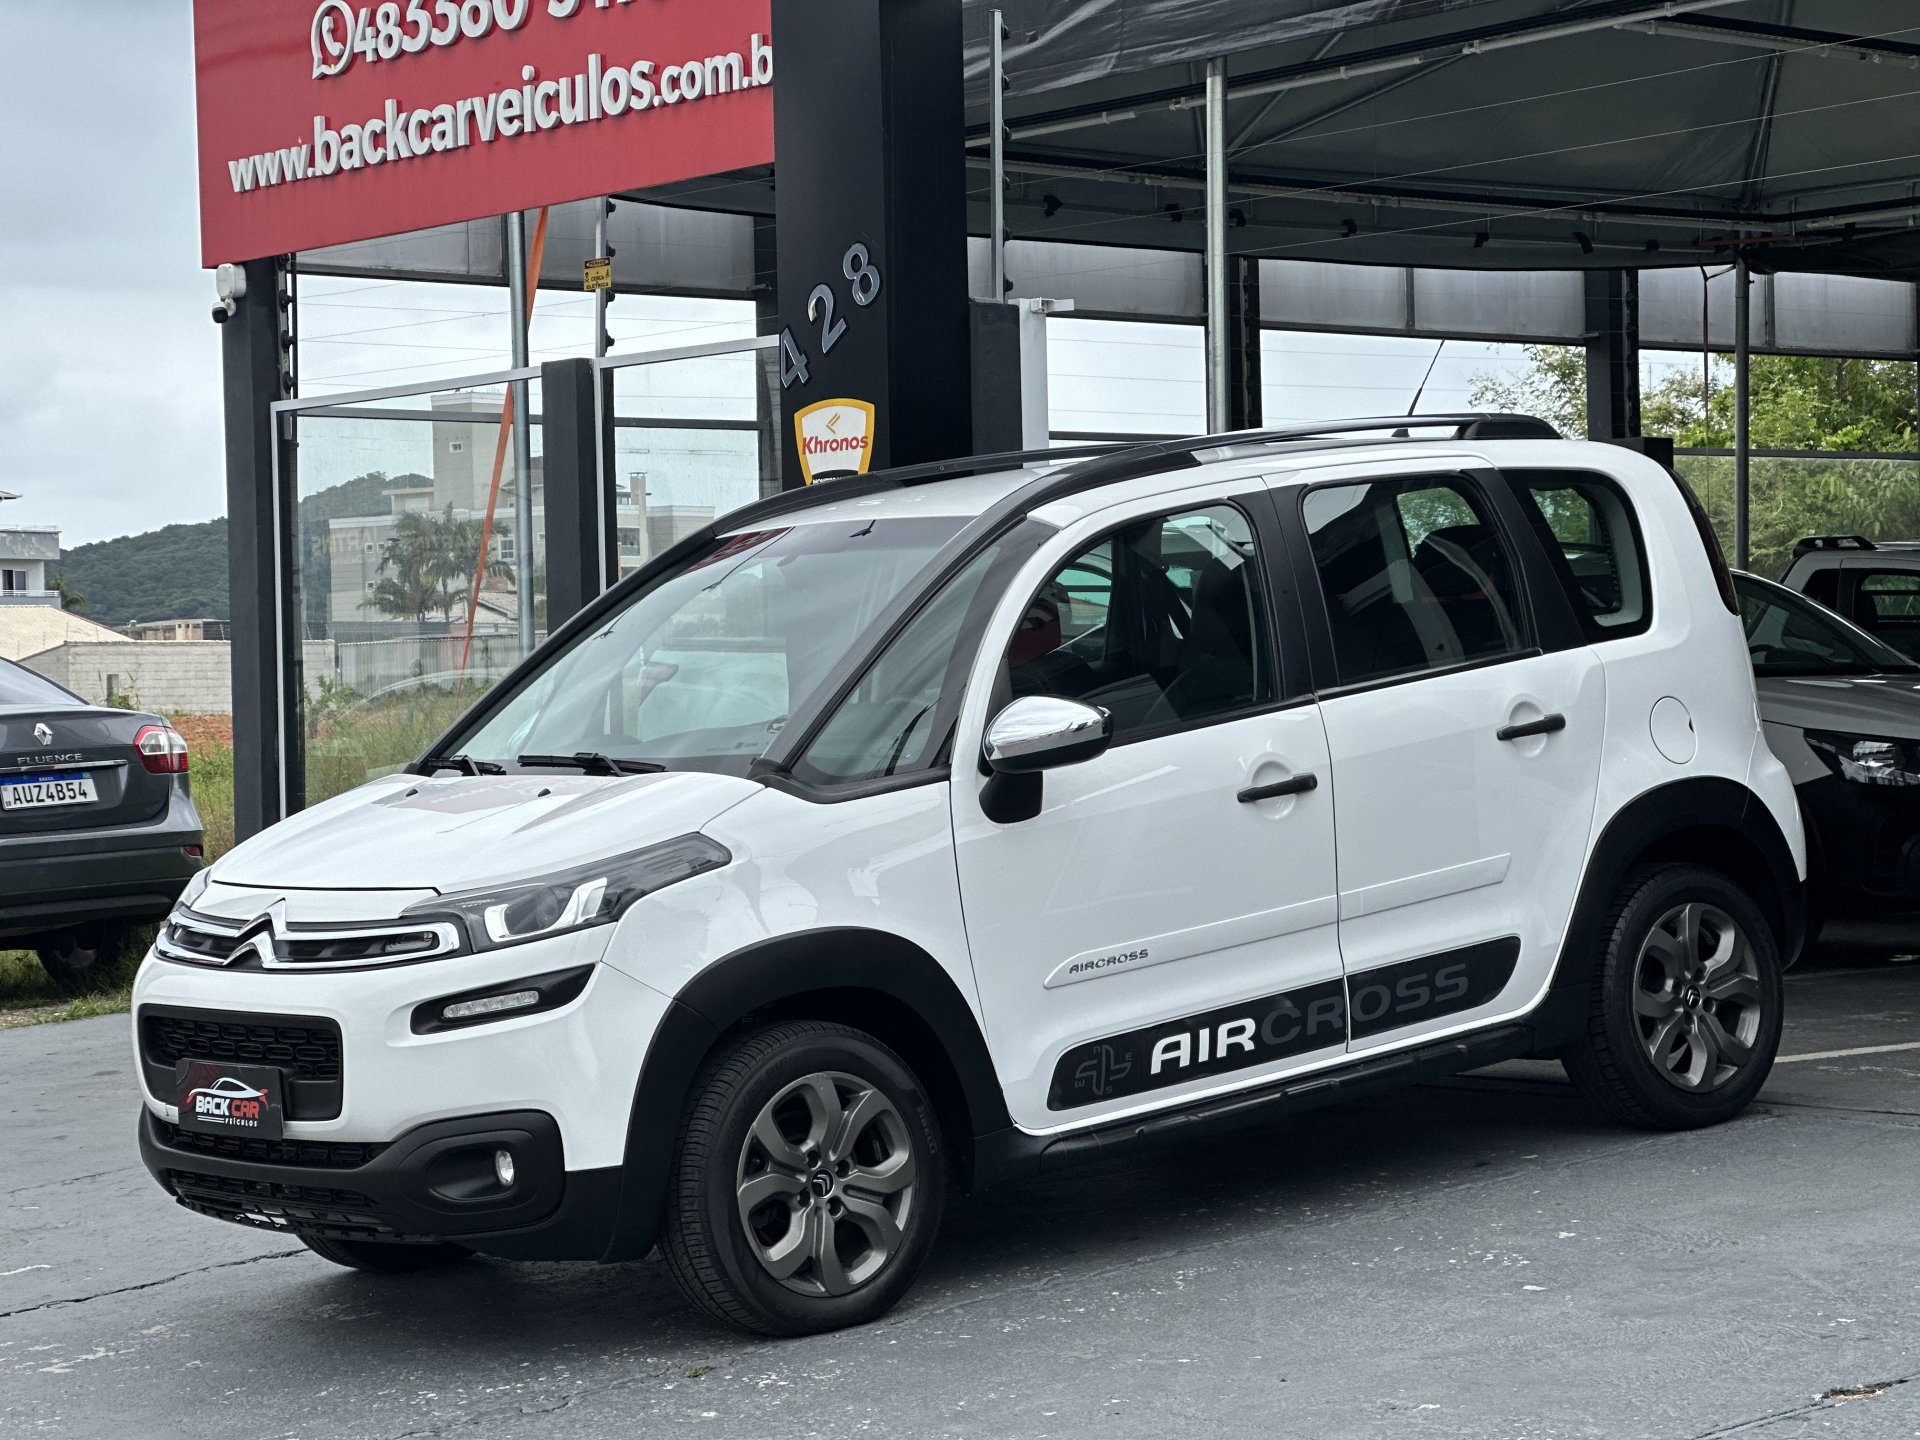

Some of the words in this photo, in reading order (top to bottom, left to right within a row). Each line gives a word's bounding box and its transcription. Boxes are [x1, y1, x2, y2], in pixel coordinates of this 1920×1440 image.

[780, 242, 880, 389] 428
[802, 435, 869, 455] Khronos
[17, 753, 83, 766] FLUENCE
[12, 781, 87, 806] AUZ4B54
[1068, 948, 1149, 975] AIRCROSS
[1150, 963, 1470, 1075] AIRCROSS
[196, 1095, 231, 1116] BACK
[231, 1099, 260, 1119] CAR
